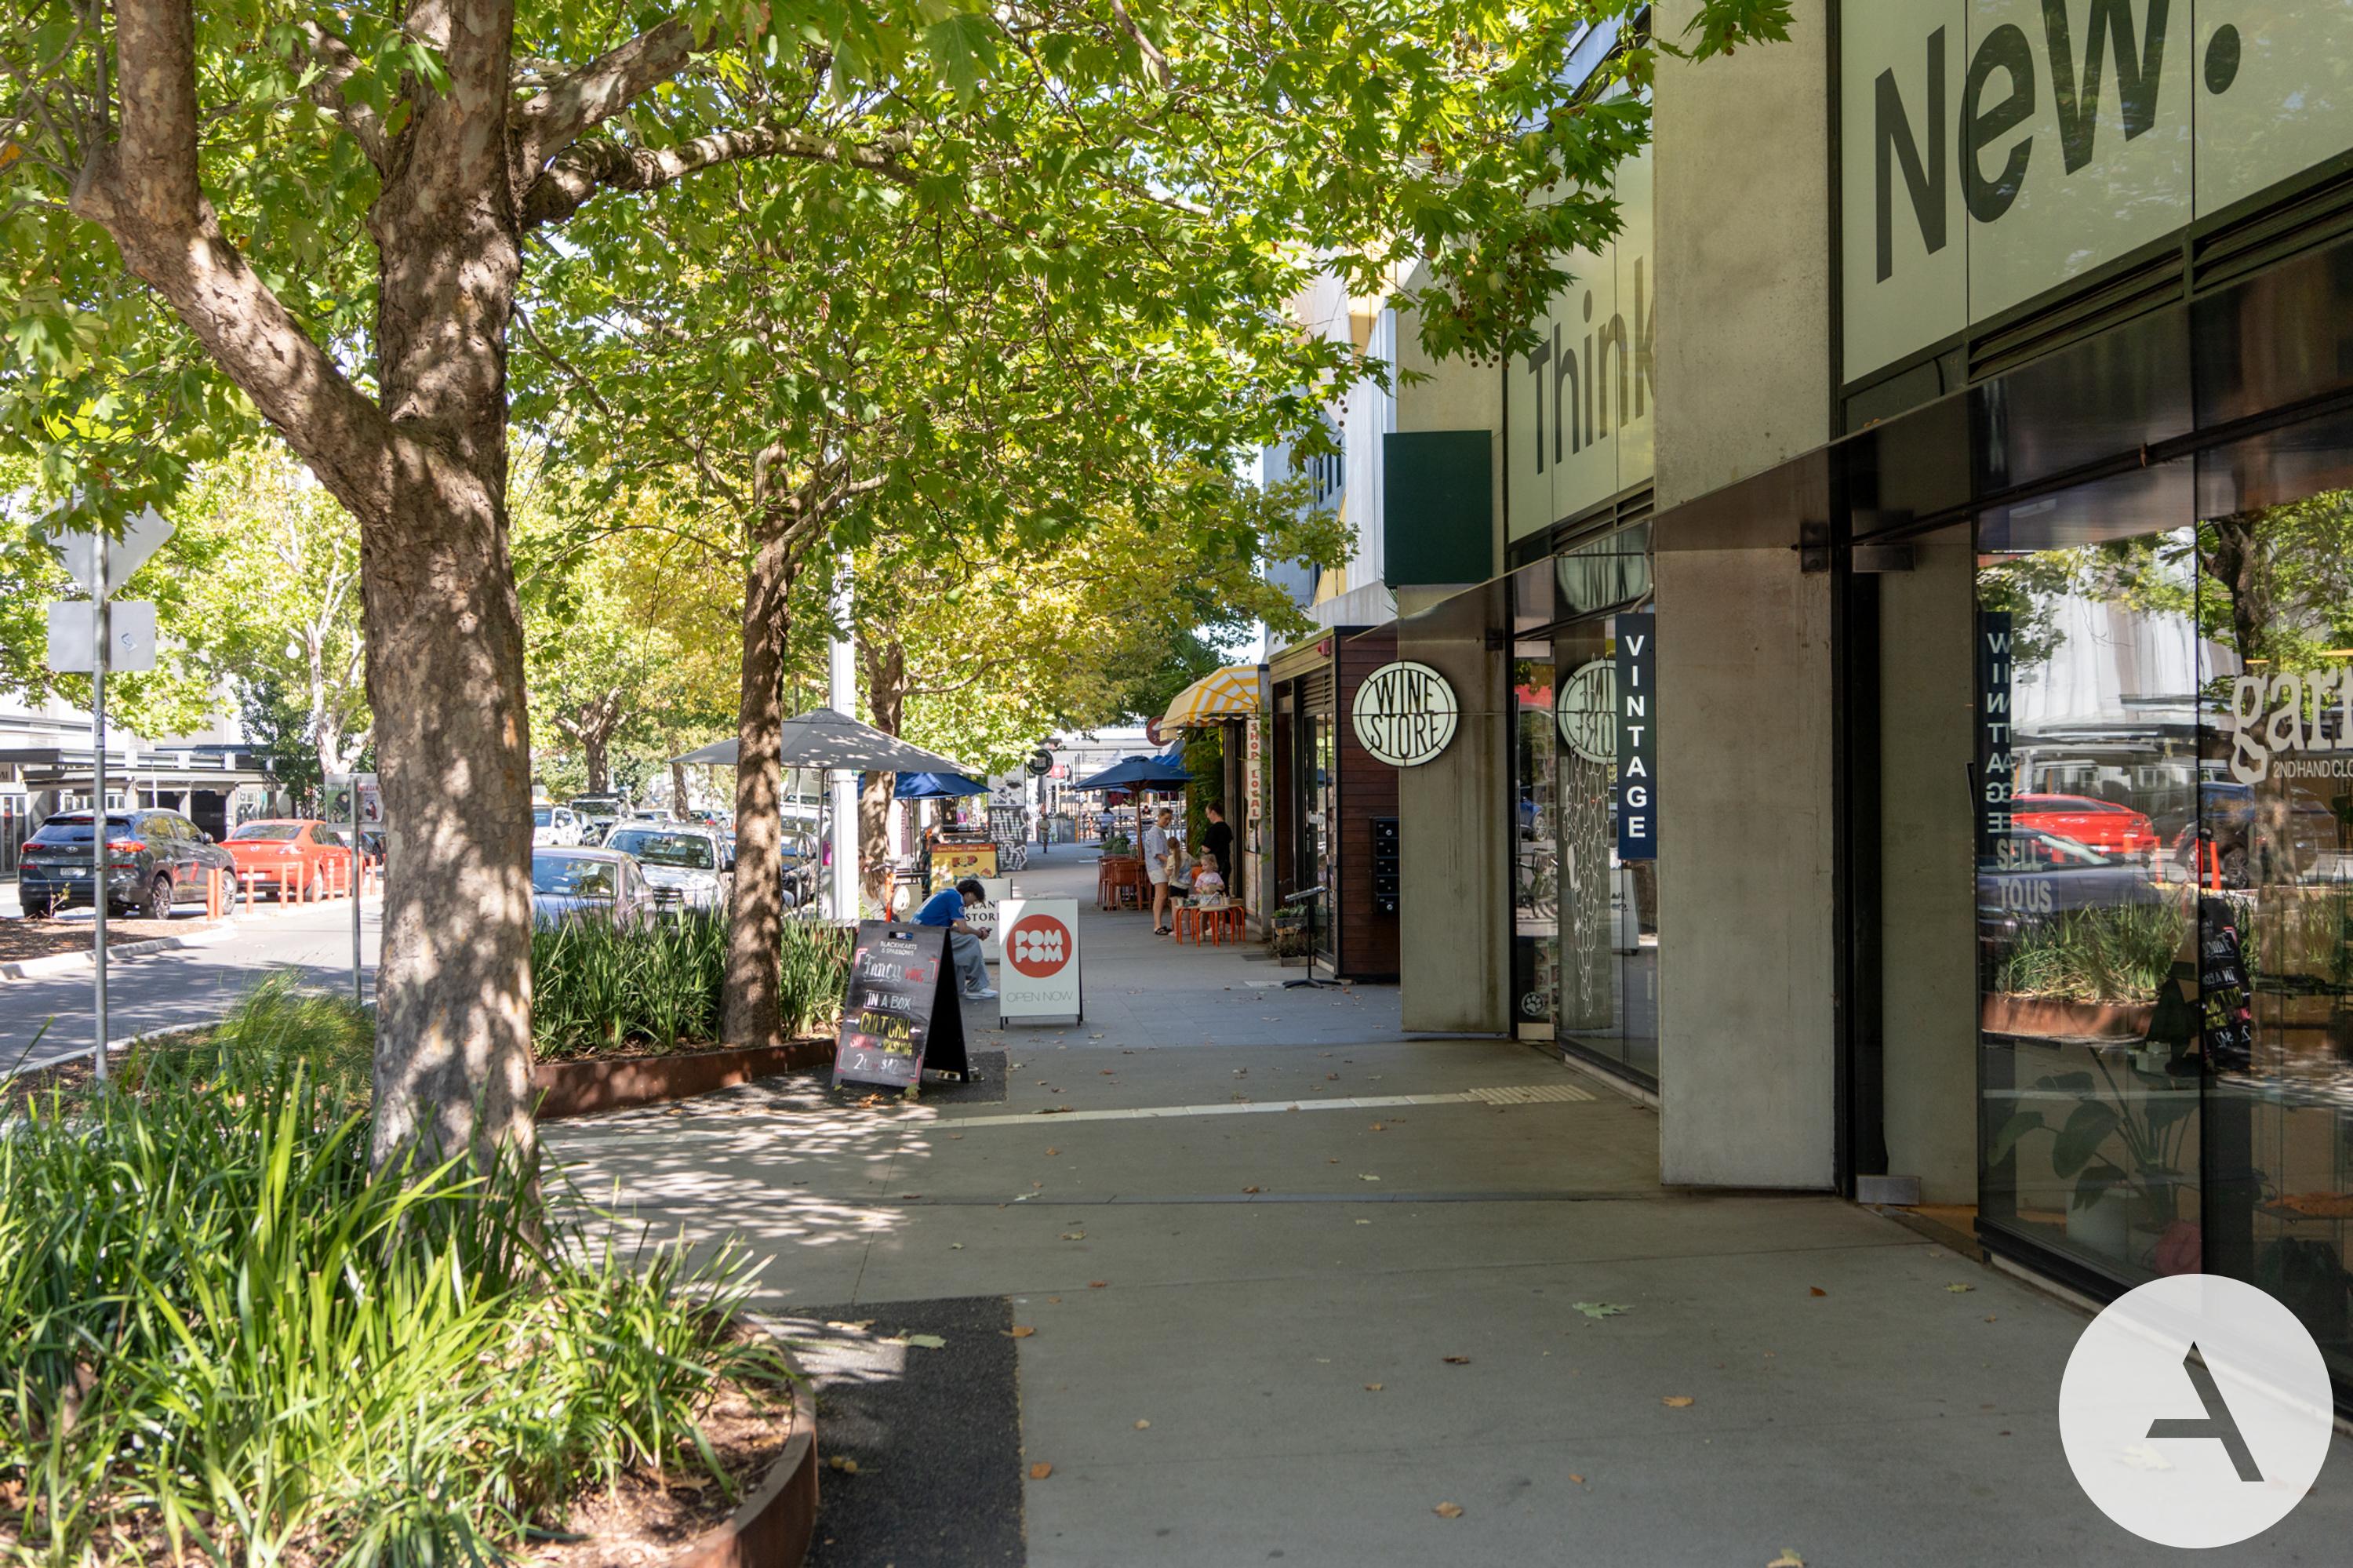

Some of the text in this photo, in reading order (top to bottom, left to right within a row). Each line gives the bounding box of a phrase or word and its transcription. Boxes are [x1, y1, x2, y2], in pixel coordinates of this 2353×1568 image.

[1529, 255, 1654, 475] Think
[1375, 669, 1435, 714] WINE
[1369, 711, 1440, 759] STORE
[1625, 635, 1648, 839] VINTAGE
[1250, 722, 1260, 817] SHOP LOCAL
[2273, 760, 2297, 778] 2ND
[2297, 759, 2331, 778] HAND
[1996, 839, 2043, 871] SELL
[966, 900, 999, 910] LAN
[1998, 878, 2053, 914] TO US
[879, 940, 918, 951] BLACKHEARTS
[1015, 929, 1064, 947] POM
[863, 953, 902, 982] Fancy
[1015, 945, 1064, 964] POM
[867, 992, 911, 1010] IN A BOX
[1006, 991, 1074, 1003] OPEN NOW
